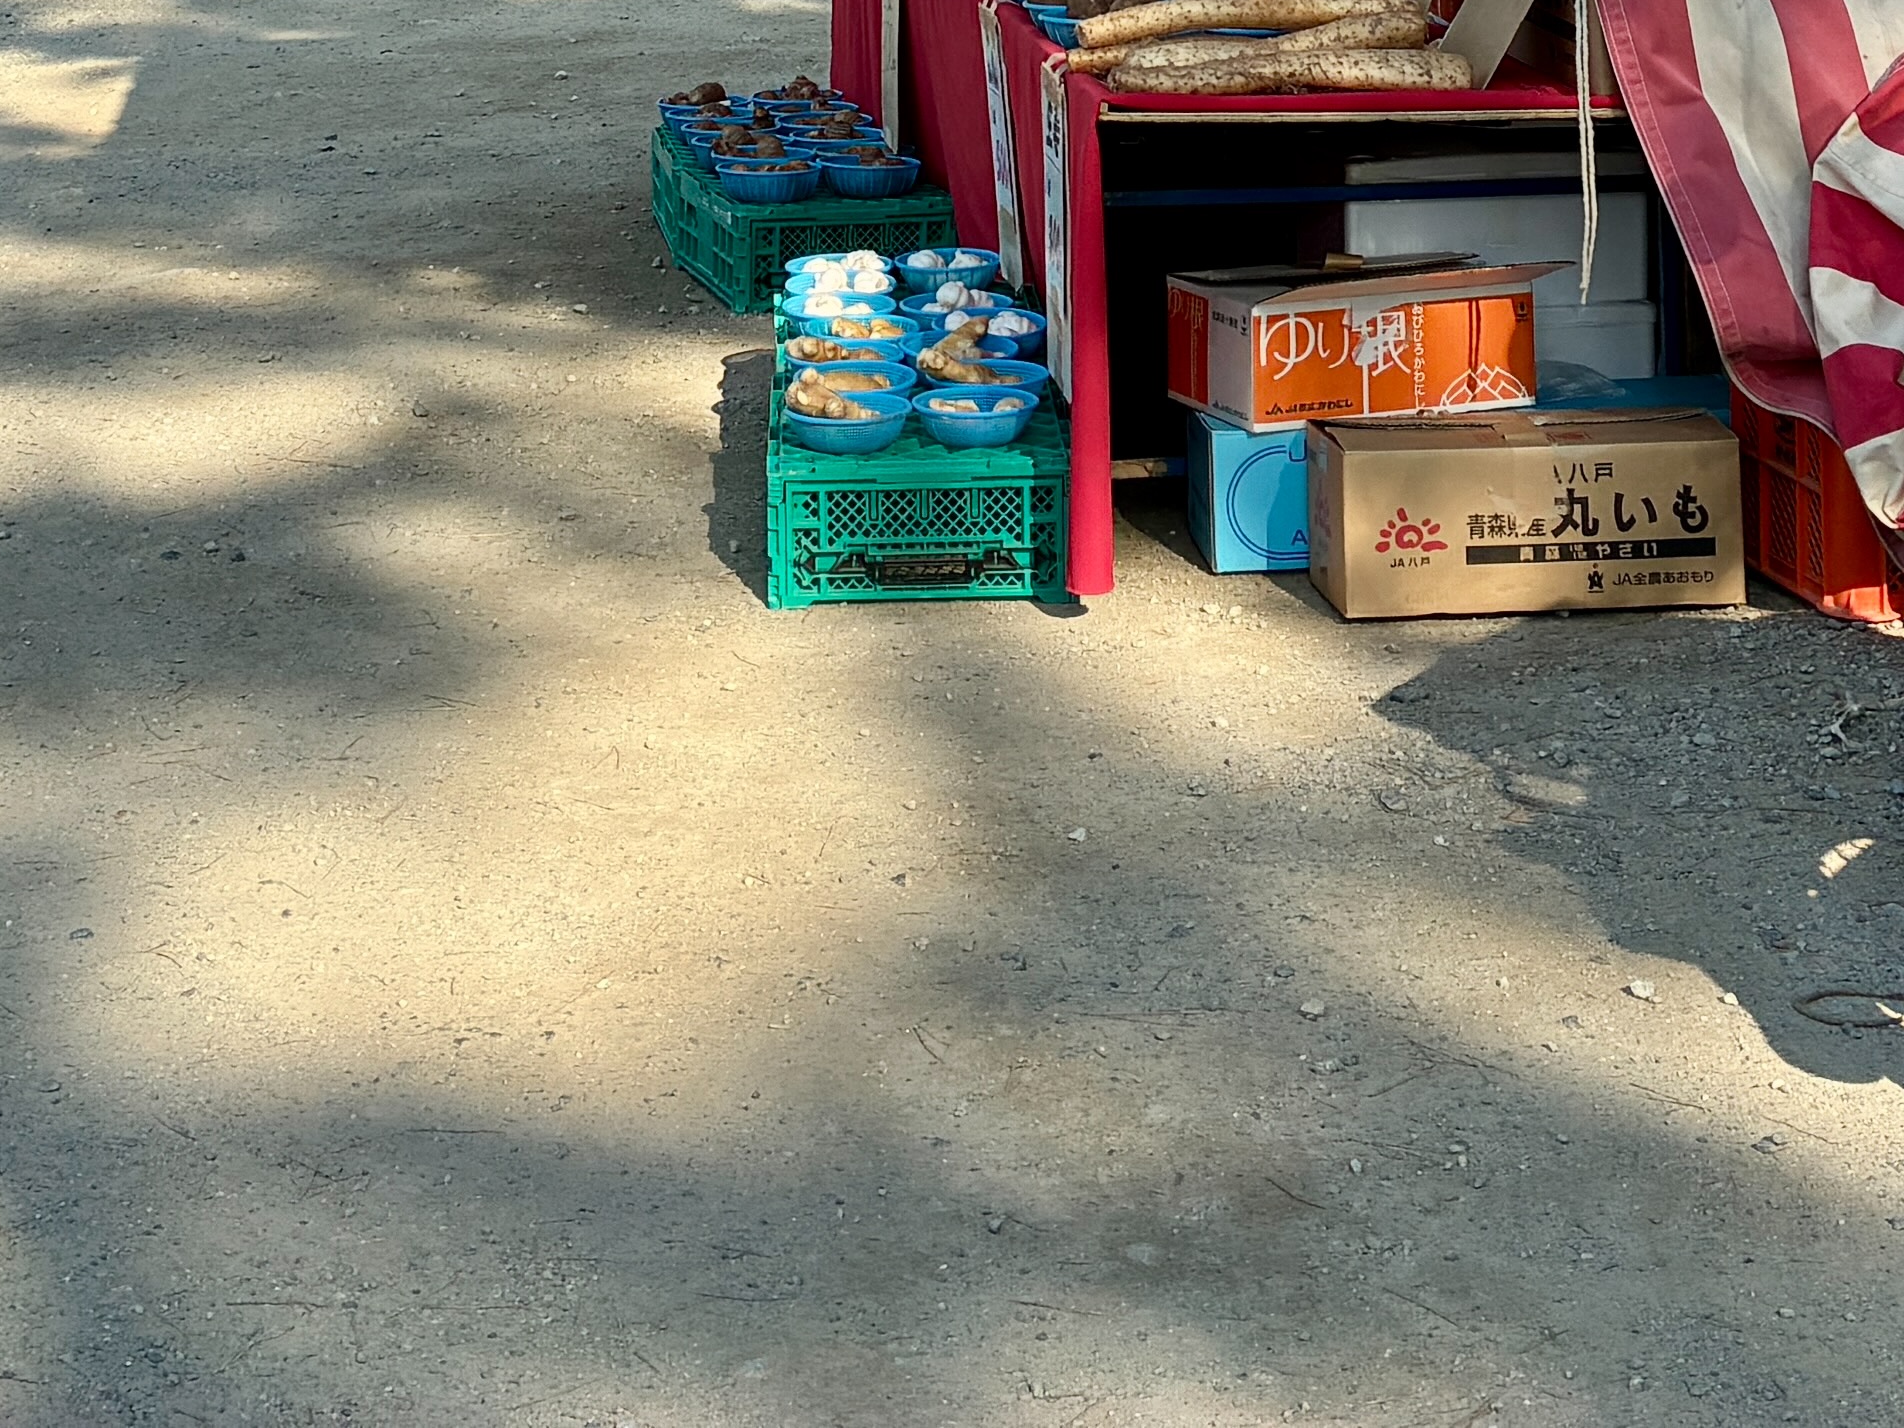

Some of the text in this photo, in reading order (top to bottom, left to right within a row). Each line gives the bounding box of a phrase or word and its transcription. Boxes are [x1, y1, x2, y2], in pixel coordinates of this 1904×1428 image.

[1259, 310, 1412, 381] ゆり根
[1551, 484, 1709, 539] 丸いも
[1612, 570, 1714, 587] JA全農あおもり
